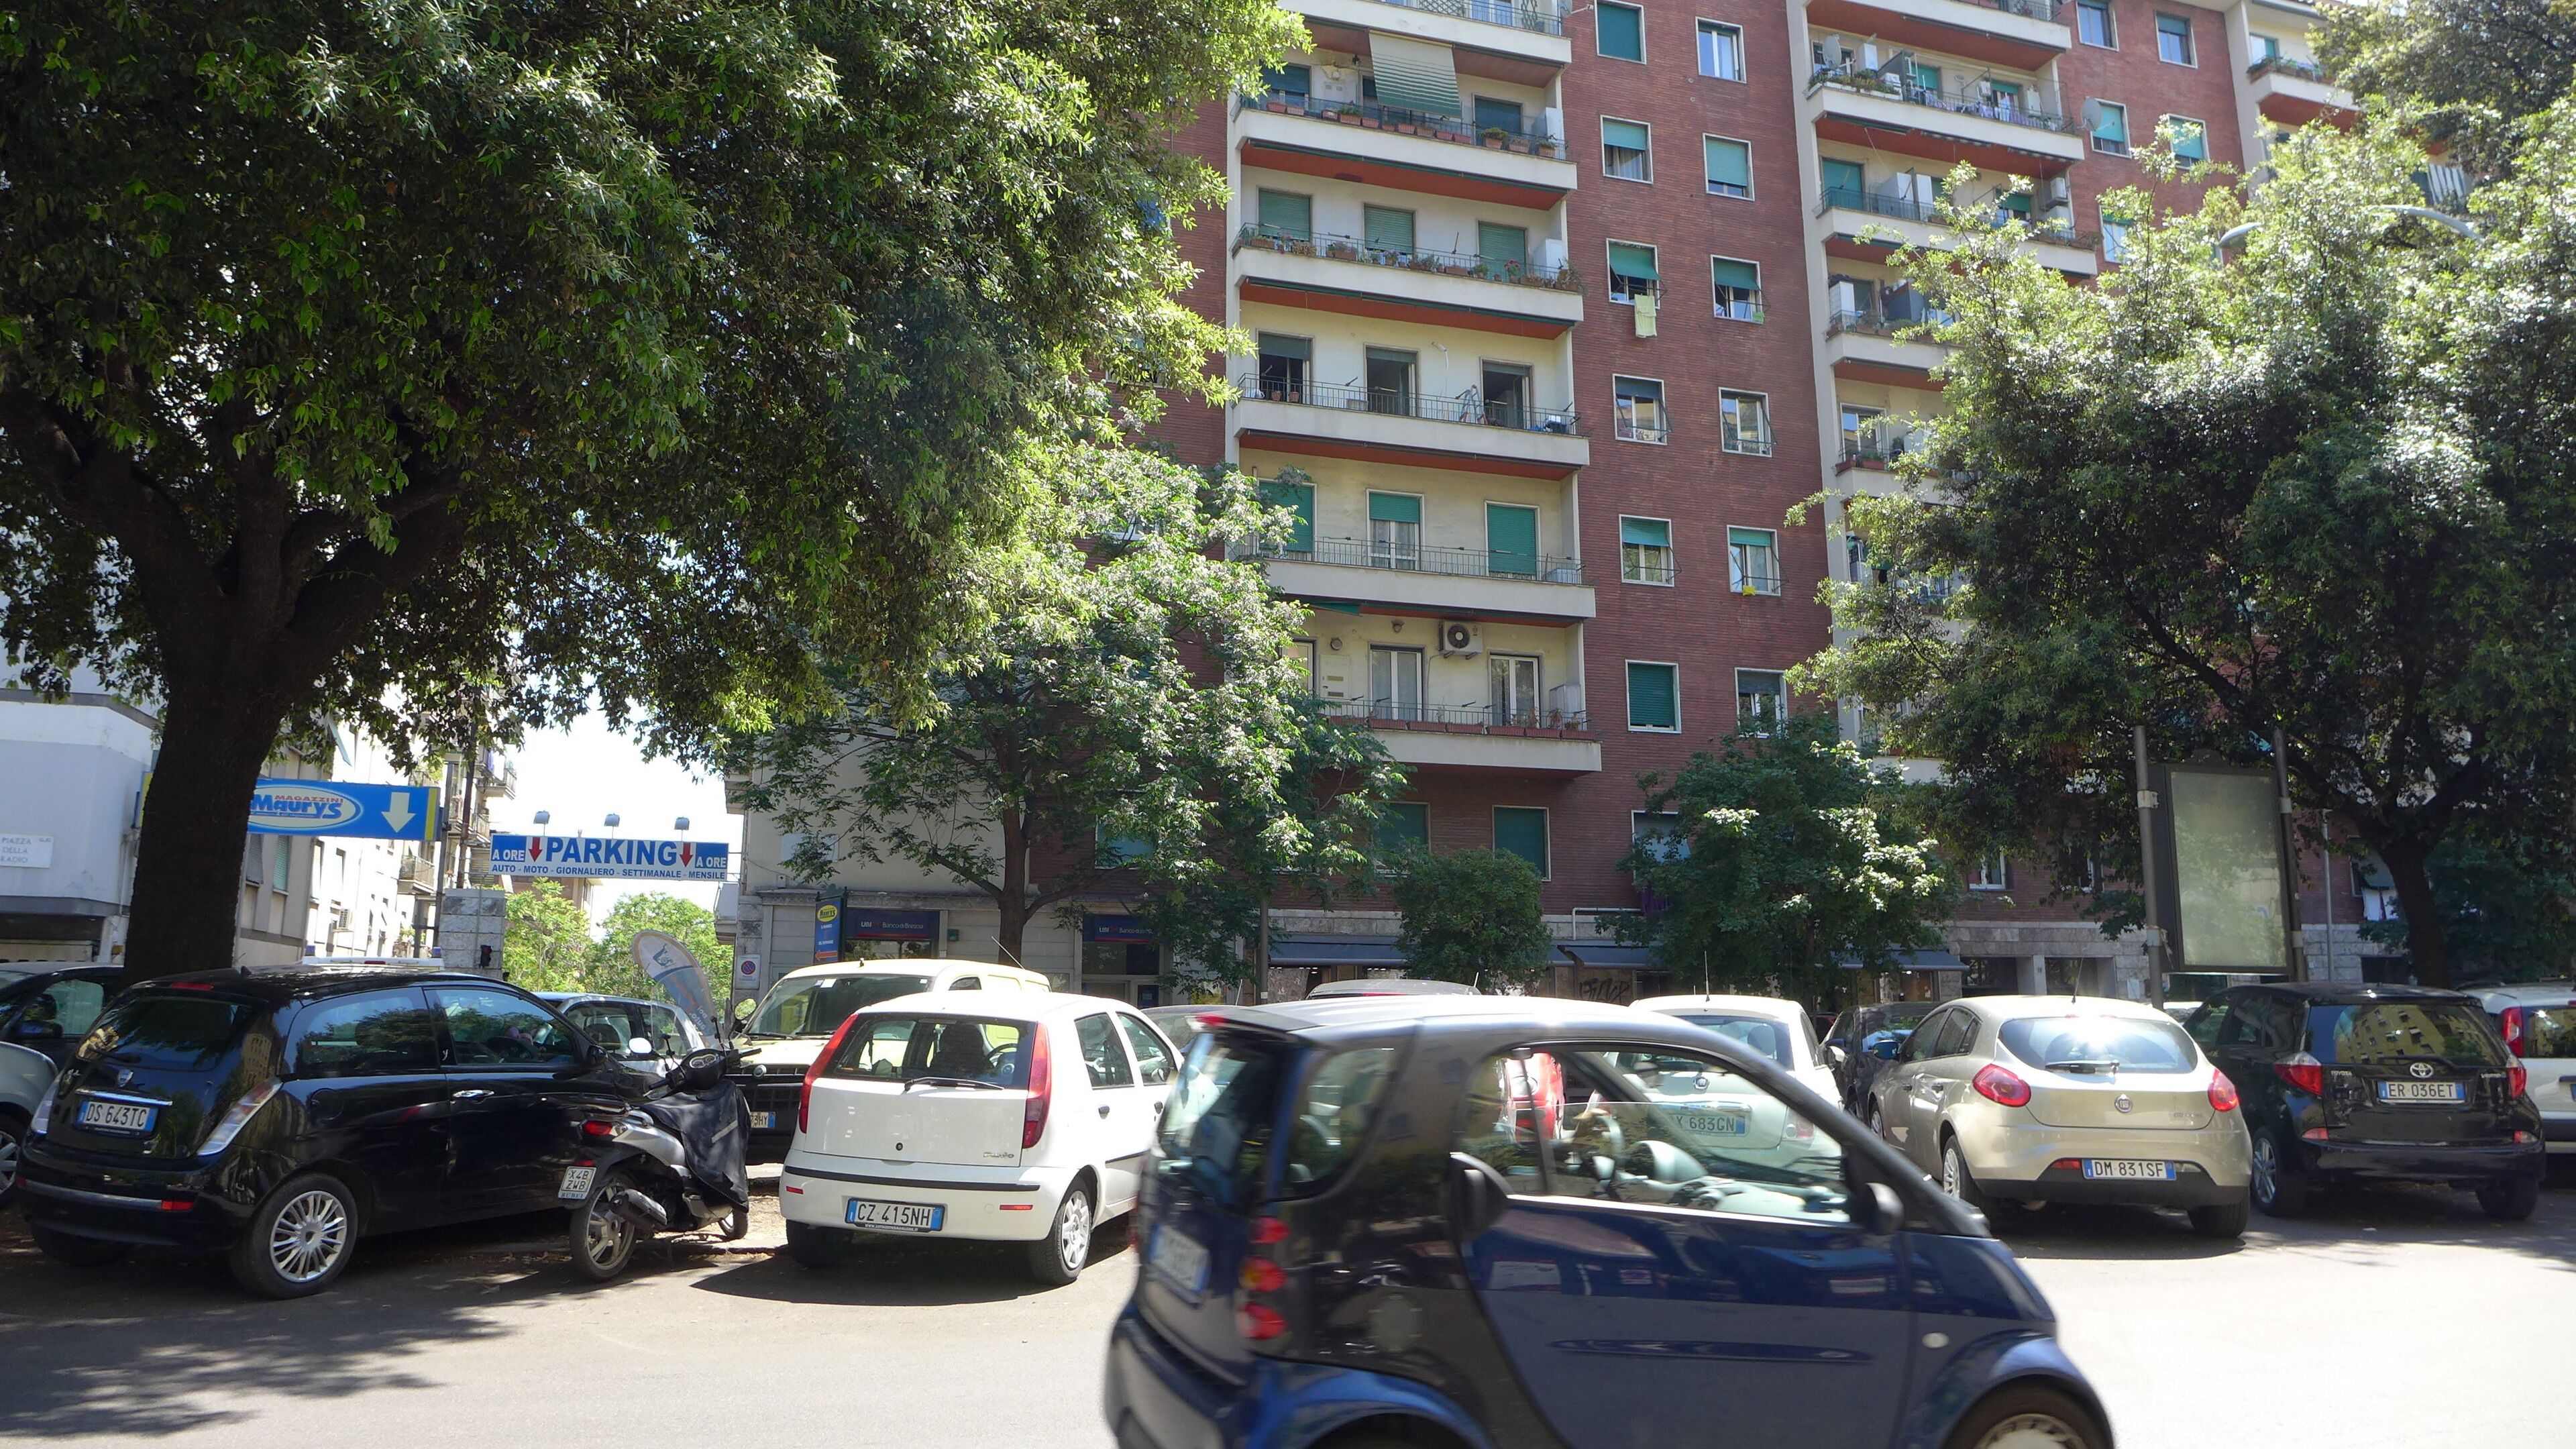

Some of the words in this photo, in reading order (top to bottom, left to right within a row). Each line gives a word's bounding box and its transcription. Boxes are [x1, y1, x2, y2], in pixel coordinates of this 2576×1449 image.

[250, 794, 343, 819] Maurys
[274, 795, 344, 803] MAGAZZINI
[0, 855, 28, 863] RADIO
[492, 849, 500, 861] A
[503, 849, 525, 861] ORE
[545, 837, 678, 867] PARKING
[696, 857, 704, 867] A
[706, 857, 727, 868] ORE
[492, 864, 516, 873] AUTO
[523, 865, 549, 873] MOTO
[555, 866, 615, 876] GIORNALIERO
[622, 868, 682, 878] SETTIMANALE
[688, 871, 726, 879] MENSILE
[2388, 1083, 2406, 1097] ER
[2411, 1084, 2453, 1098] 036ET
[86, 1103, 103, 1122] DS
[105, 1105, 147, 1127] 643TC
[1689, 1117, 1735, 1132] 683GN
[569, 1170, 589, 1180] X4B
[2094, 1161, 2113, 1176] DM
[2118, 1162, 2163, 1177] 831SF
[857, 1203, 876, 1222] CZ
[881, 1205, 931, 1226] 415NH
